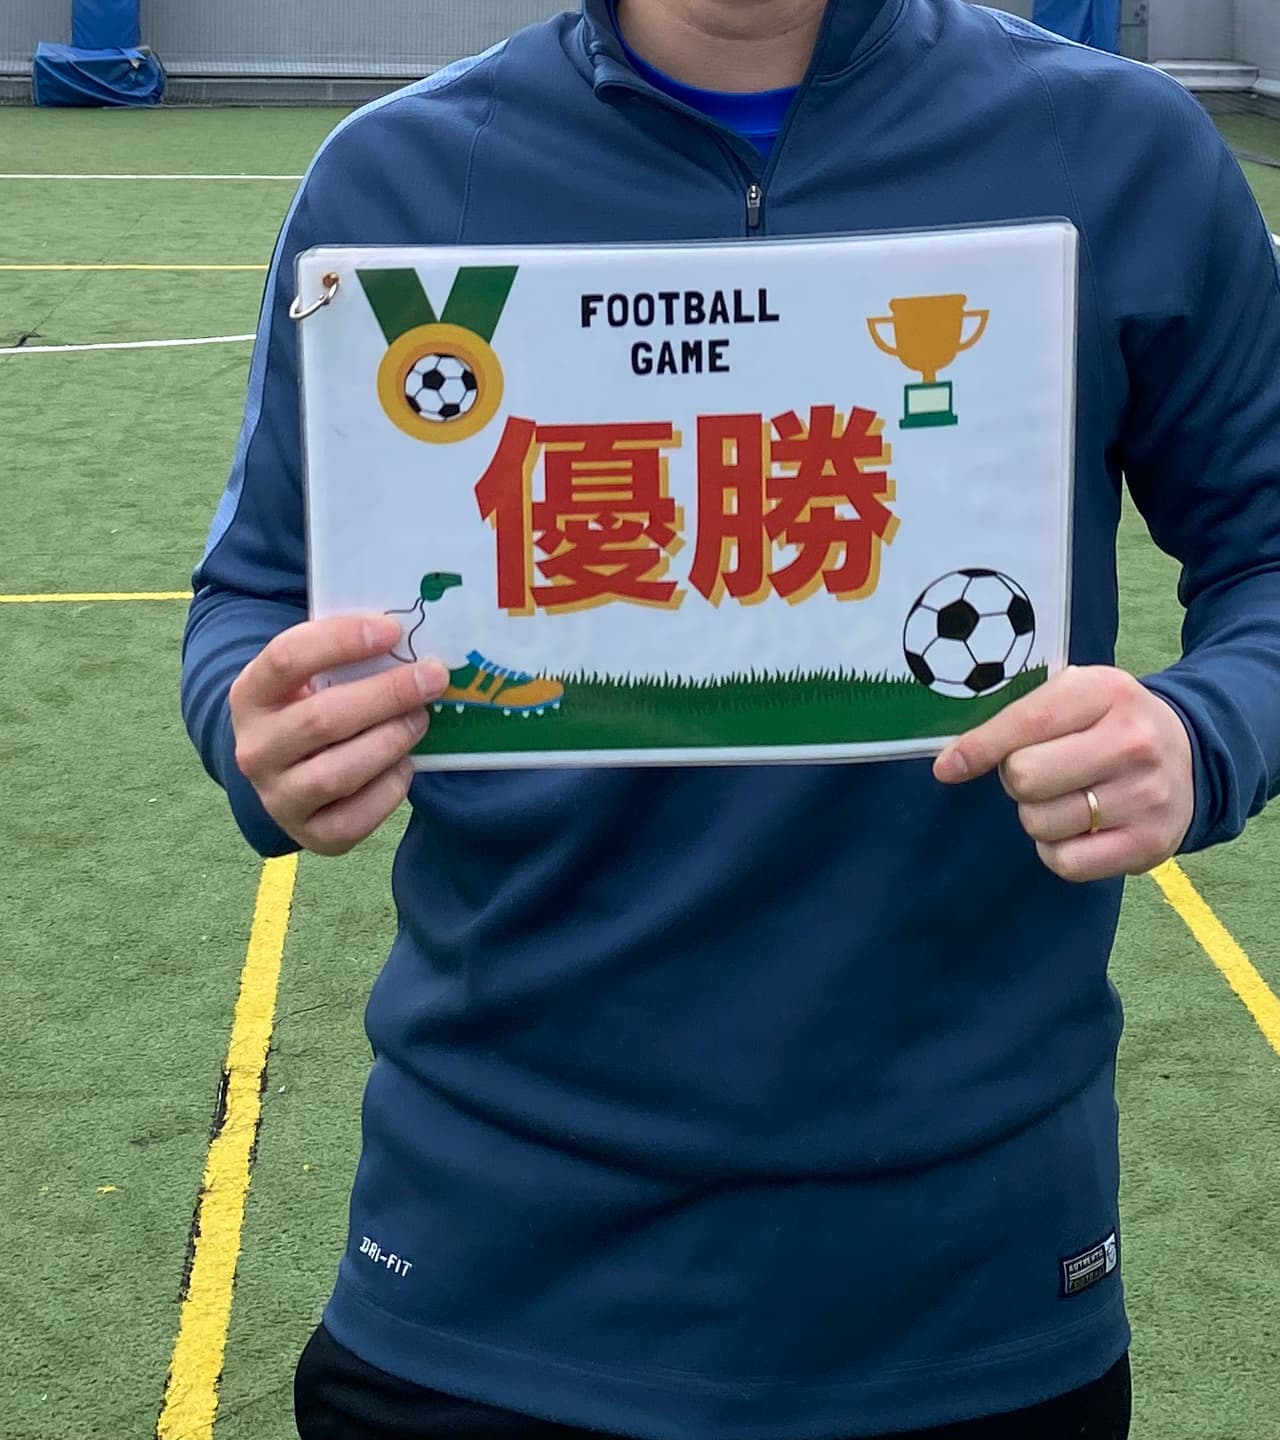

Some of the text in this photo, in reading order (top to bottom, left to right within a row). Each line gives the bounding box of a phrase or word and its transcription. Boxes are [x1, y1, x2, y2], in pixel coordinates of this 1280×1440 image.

[581, 288, 779, 327] FOOTBALL
[631, 339, 730, 375] GAME
[474, 405, 900, 617] 優勝
[359, 1236, 412, 1276] DRI-FIT
